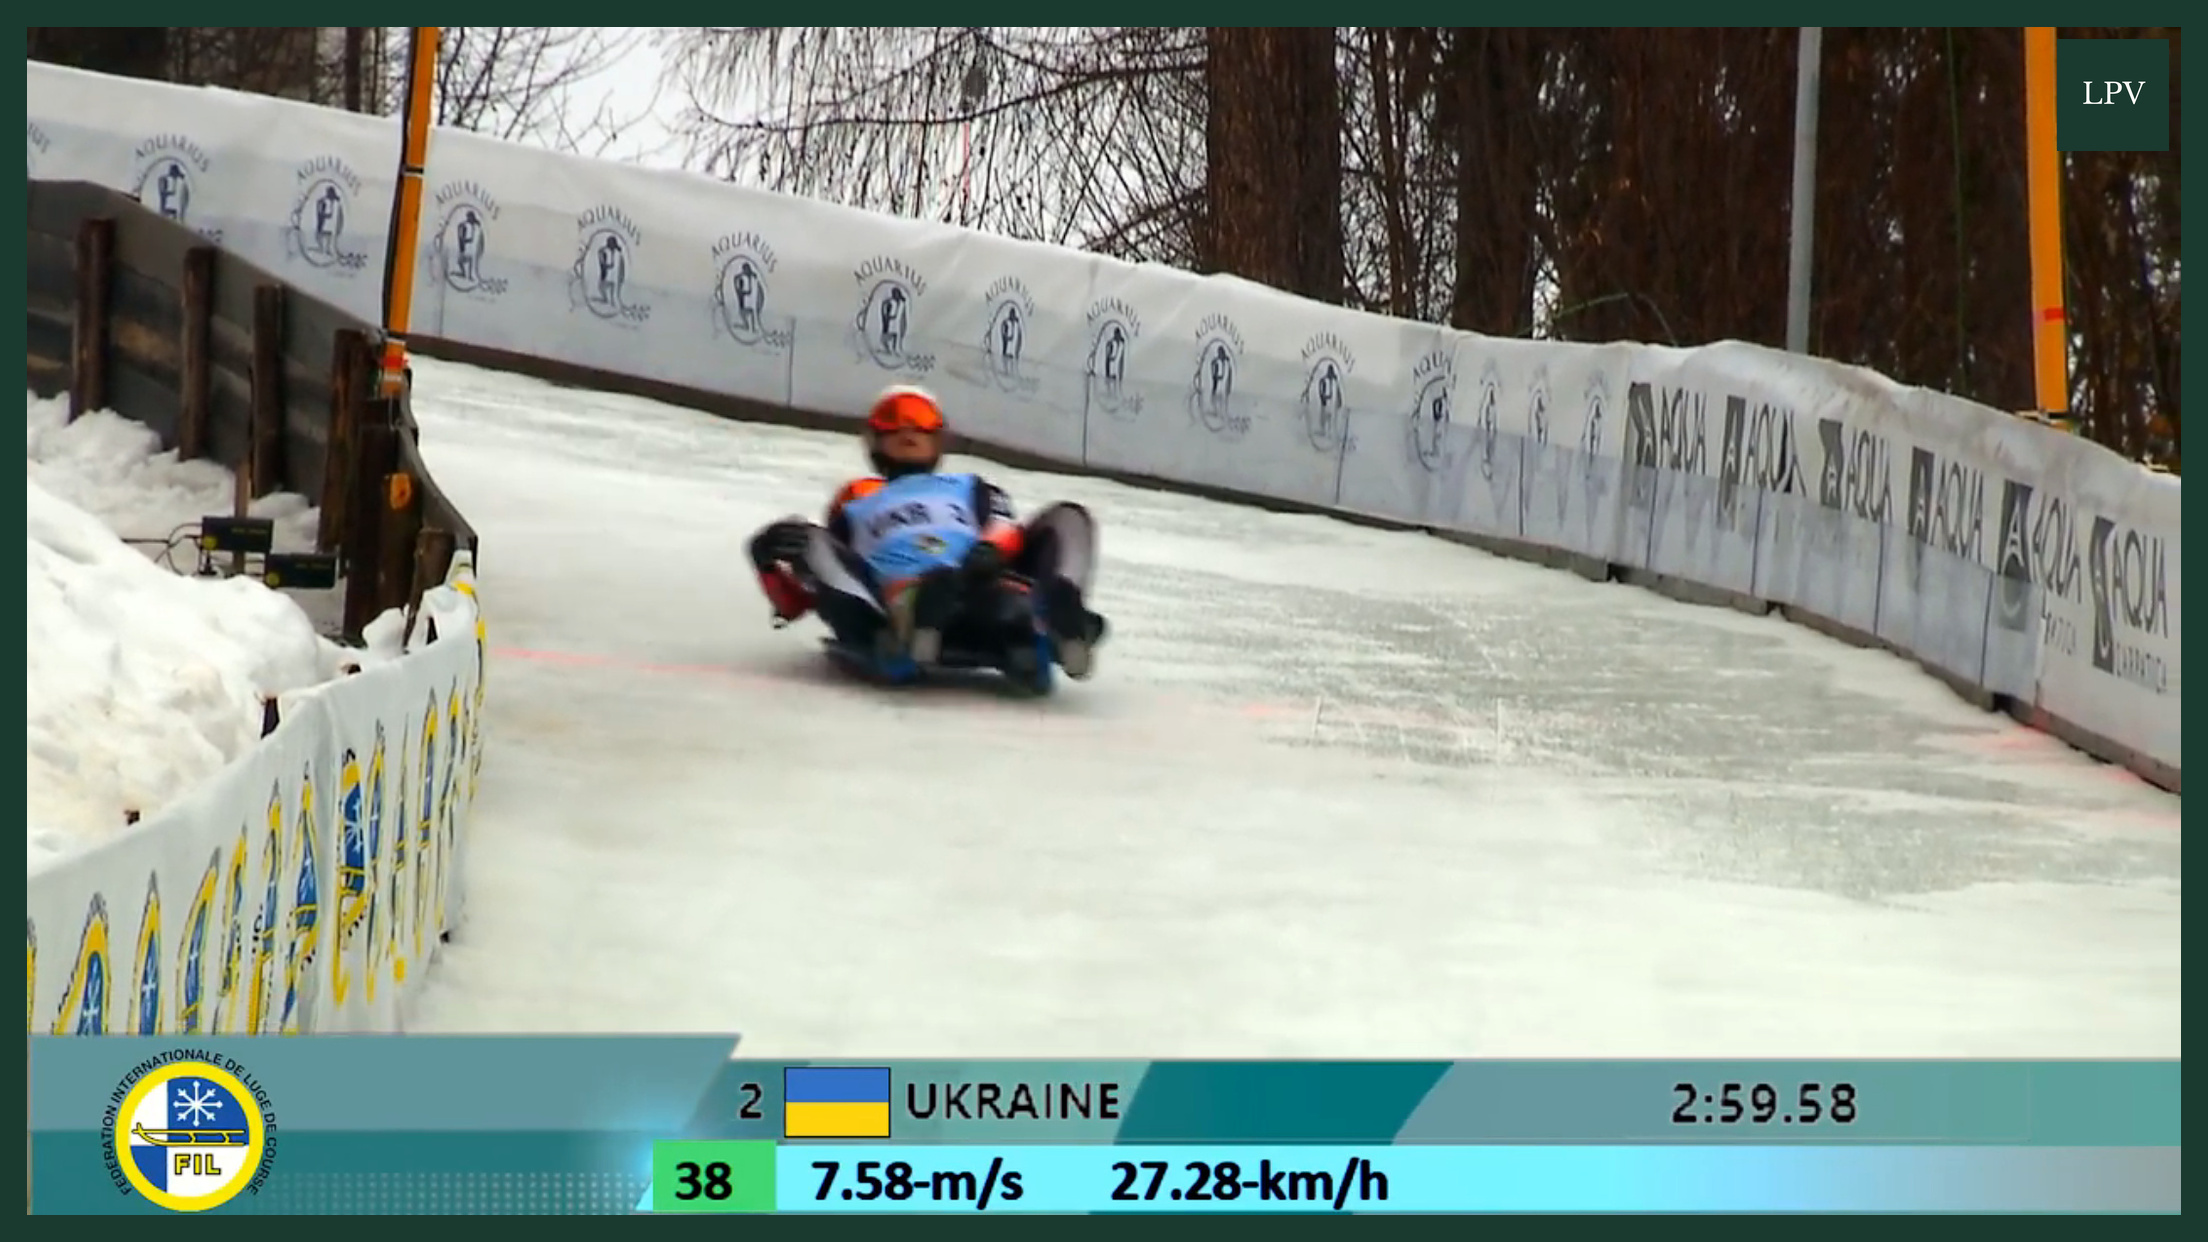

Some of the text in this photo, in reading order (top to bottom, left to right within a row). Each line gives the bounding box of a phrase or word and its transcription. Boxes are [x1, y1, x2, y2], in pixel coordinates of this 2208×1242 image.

[435, 179, 500, 221] AQUARIUS
[577, 204, 641, 246] AQUARIUS
[711, 230, 778, 274] AQUARIUS
[853, 255, 927, 297] AQUARIUS
[1086, 297, 1140, 338] AQUARIUS
[1195, 312, 1244, 355] AQUARIUS
[1301, 331, 1354, 373] AQUARIUS
[1930, 457, 1985, 565] AQUA
[2112, 528, 2168, 639] AQUA
